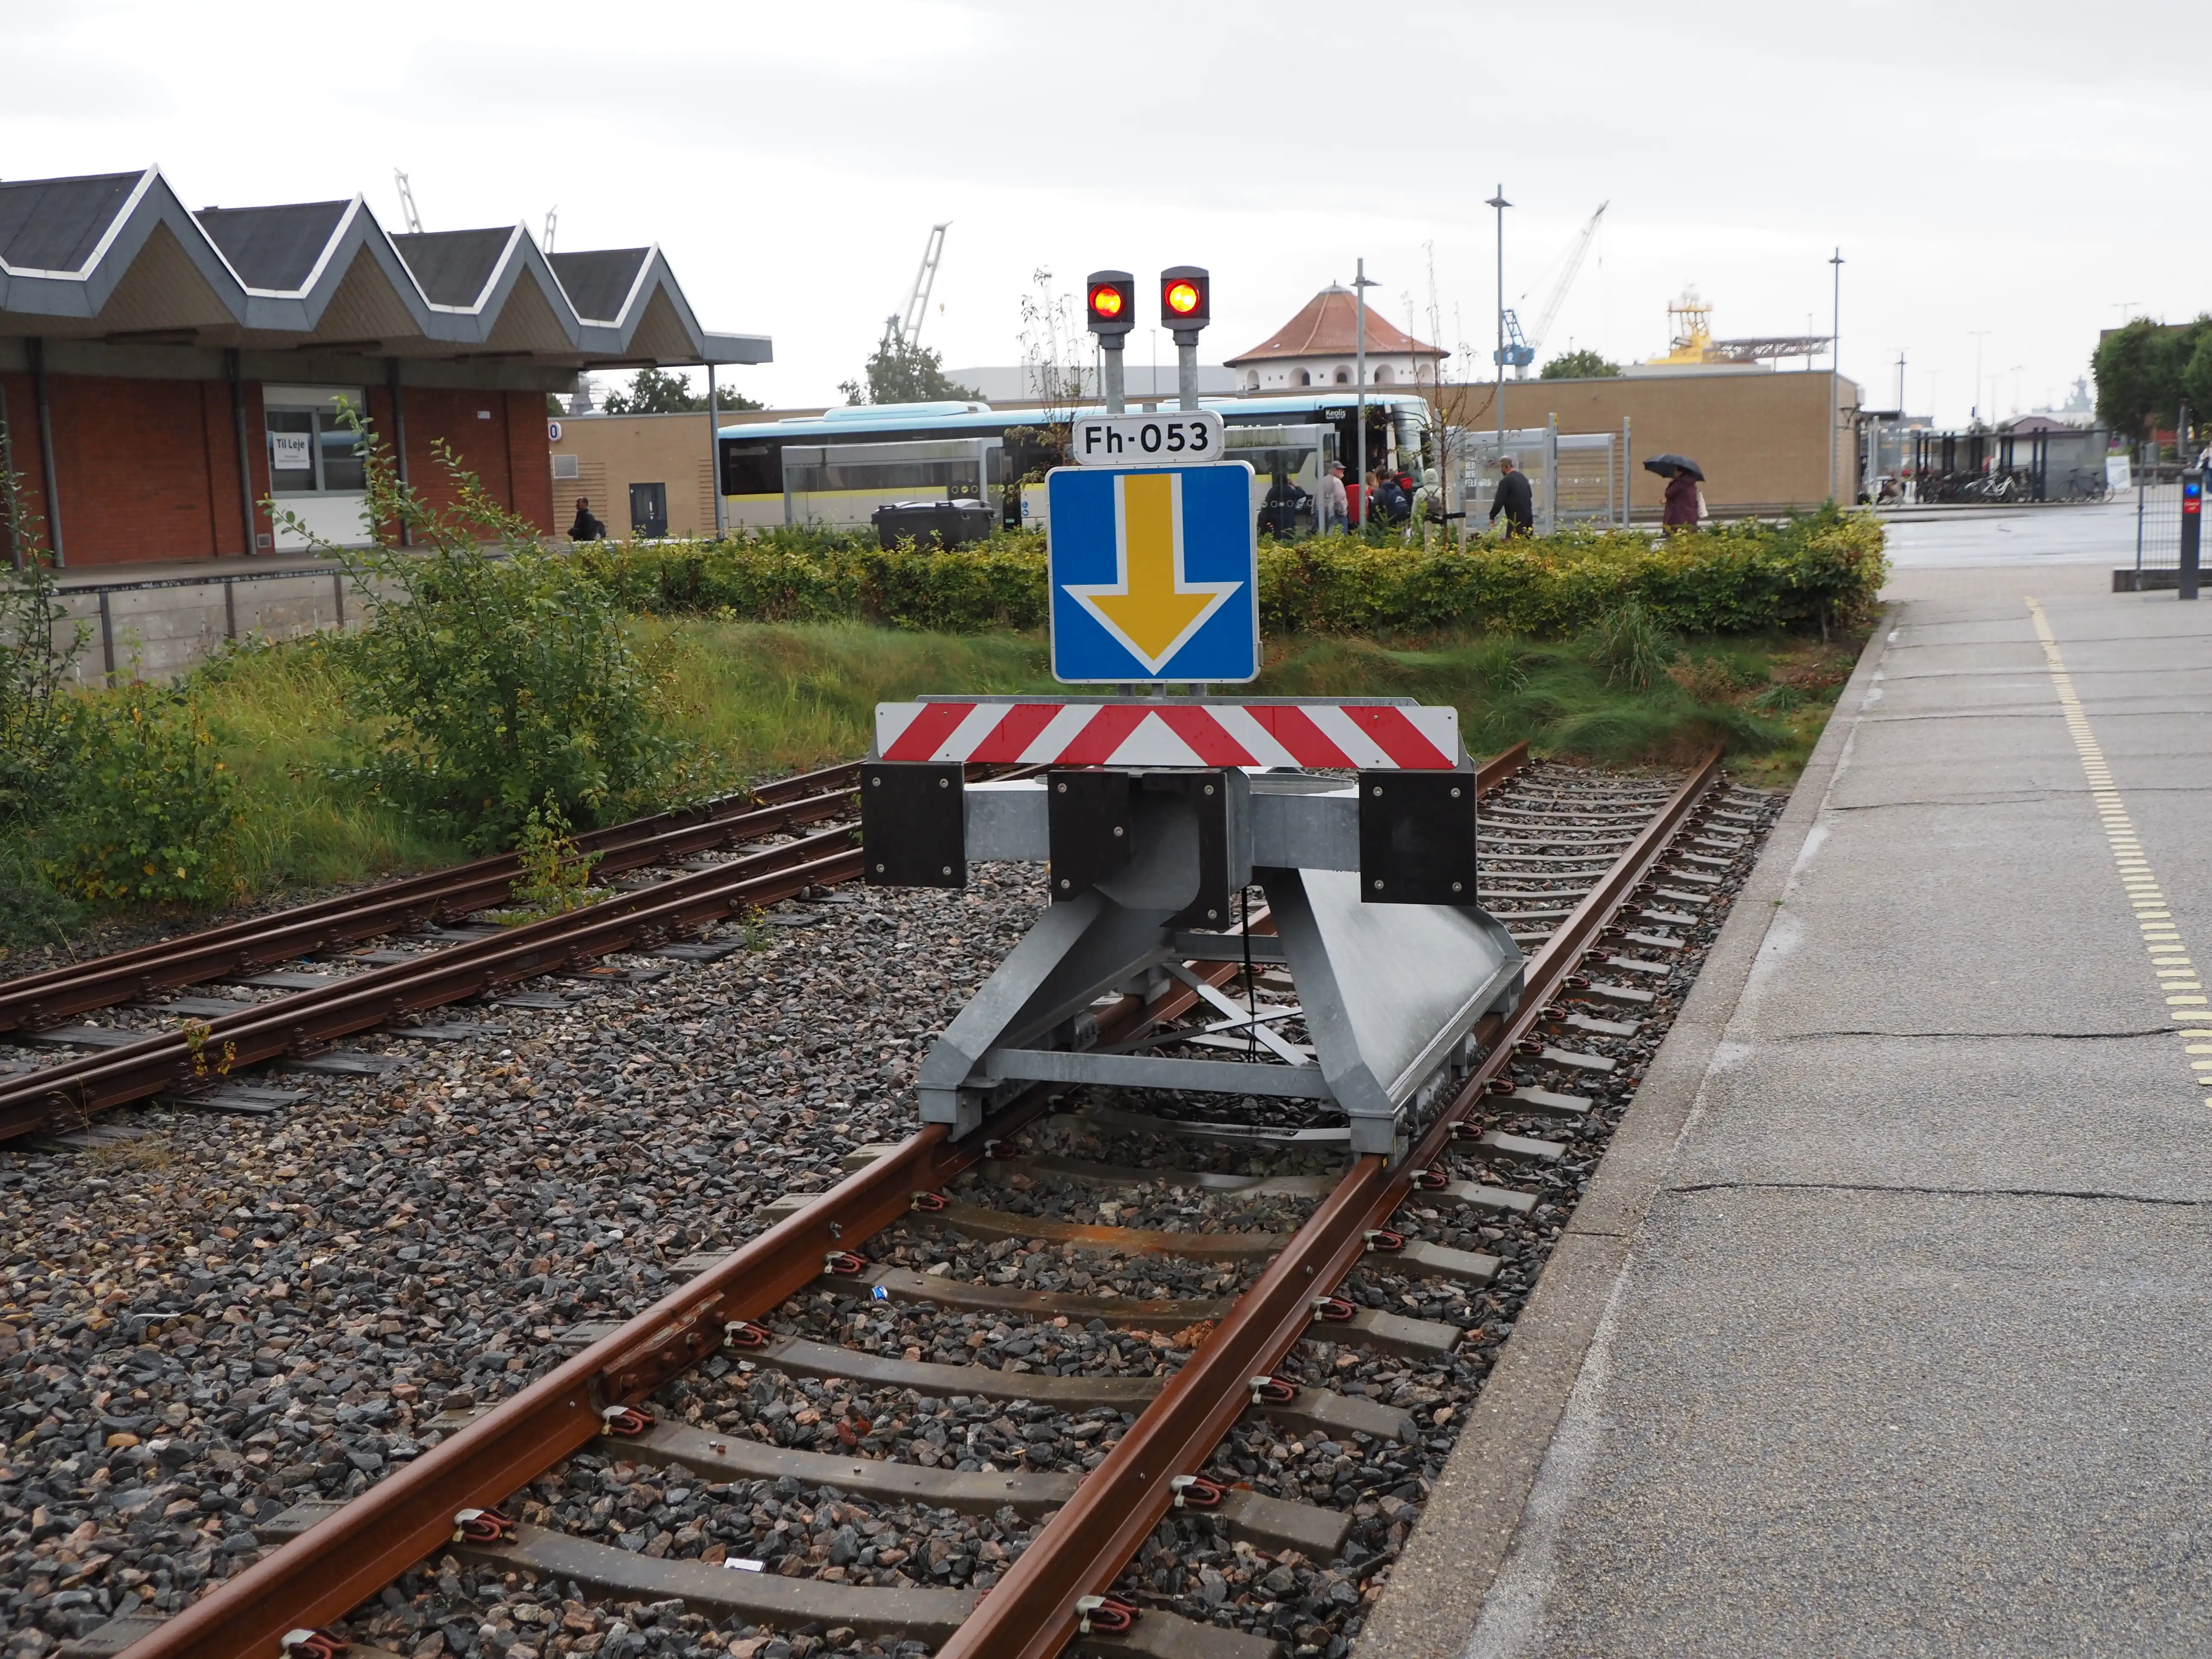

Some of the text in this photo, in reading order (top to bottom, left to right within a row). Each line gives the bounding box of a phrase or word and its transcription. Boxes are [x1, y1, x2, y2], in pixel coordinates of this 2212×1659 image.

[276, 438, 305, 451] Til Leje
[1086, 422, 1208, 454] Fh-053
